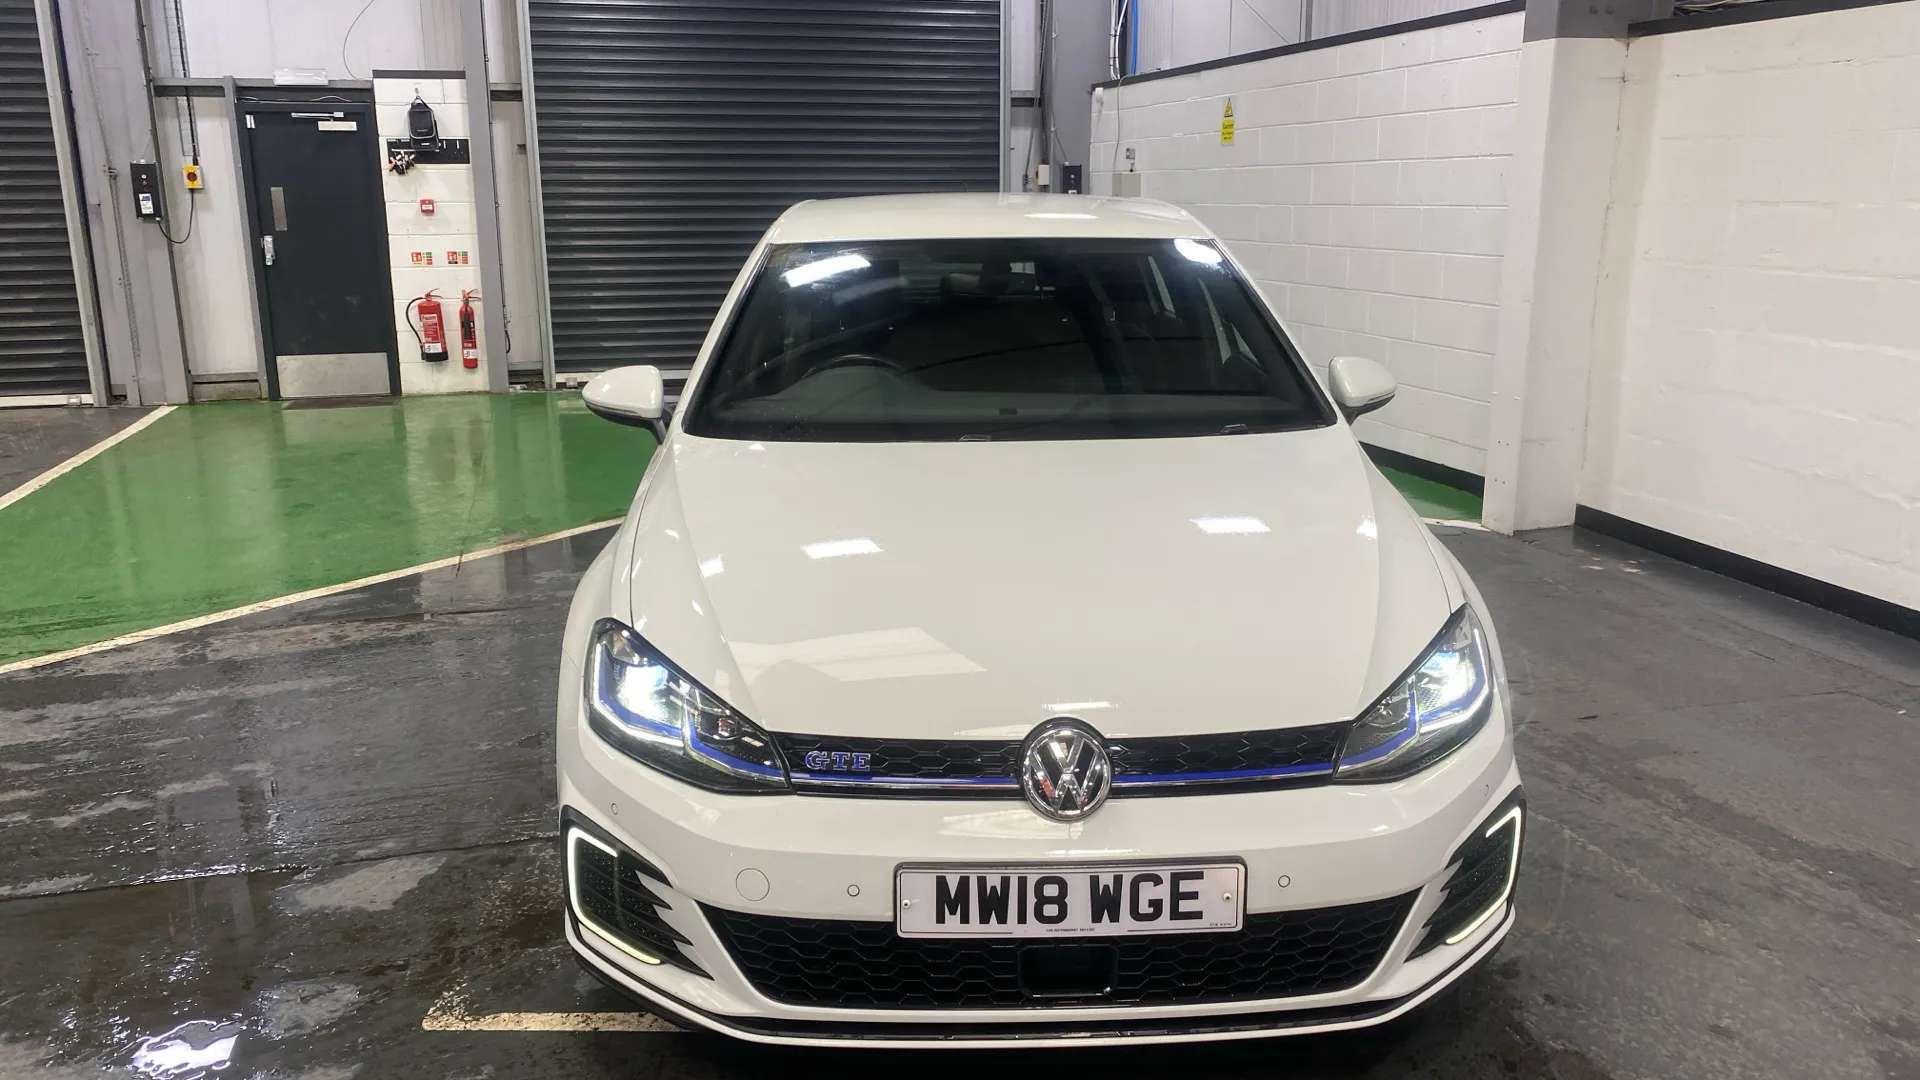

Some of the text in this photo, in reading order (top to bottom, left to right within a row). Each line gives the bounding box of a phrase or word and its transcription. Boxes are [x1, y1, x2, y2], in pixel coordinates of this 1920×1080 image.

[805, 750, 871, 771] GTE
[935, 871, 1204, 925] MW18 WGE
